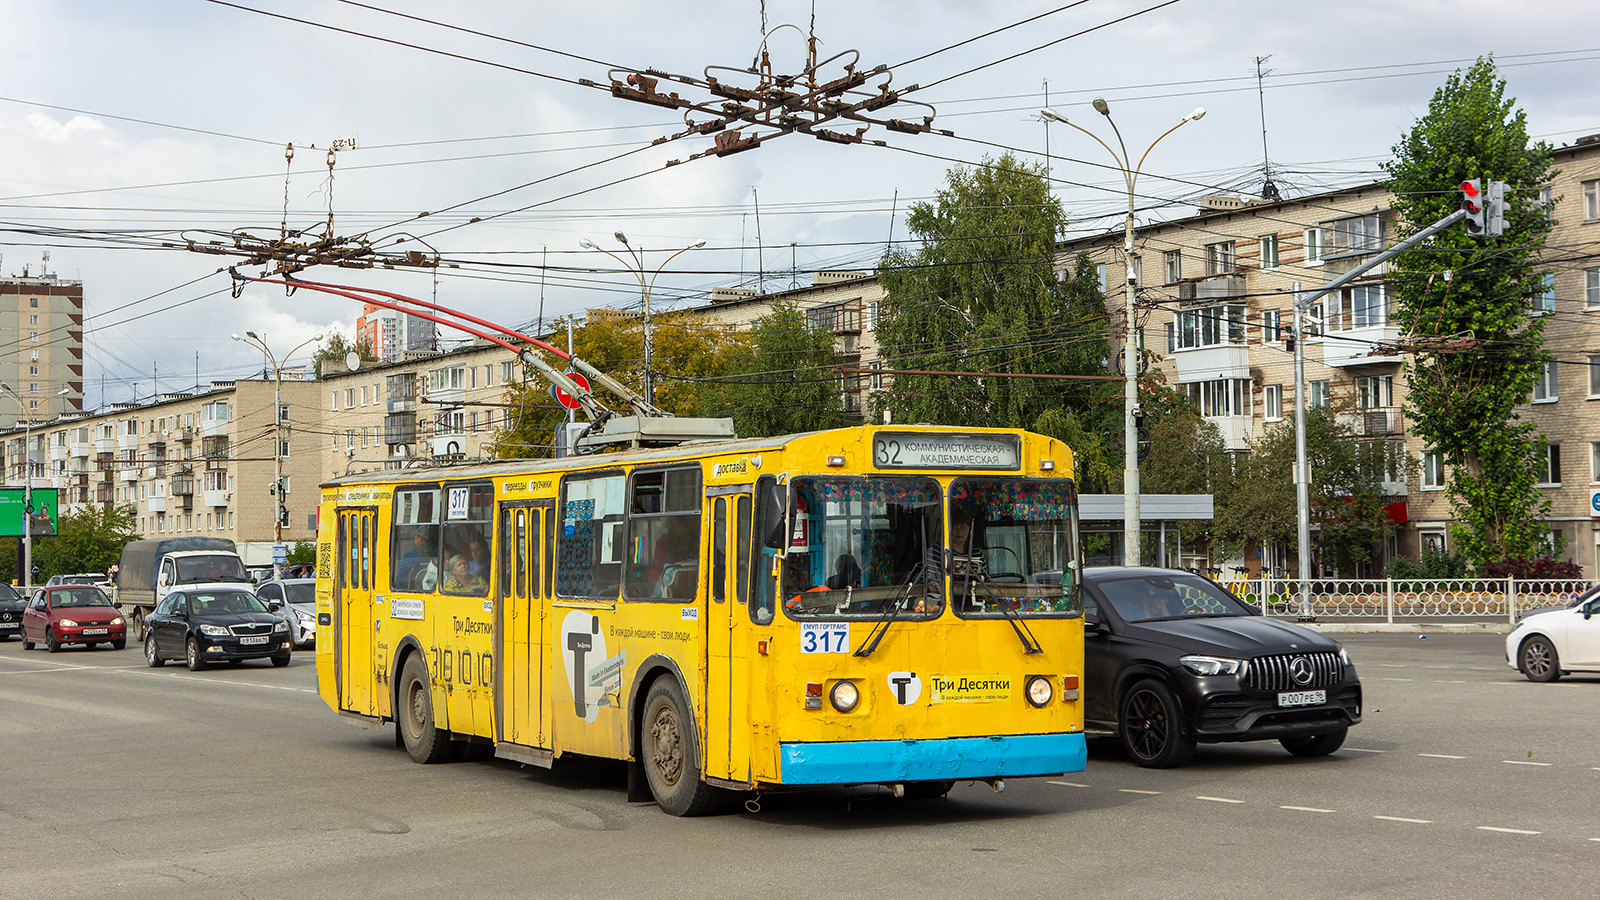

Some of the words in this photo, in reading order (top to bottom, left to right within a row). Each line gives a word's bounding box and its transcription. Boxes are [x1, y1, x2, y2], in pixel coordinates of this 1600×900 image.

[333, 138, 356, 147] П-23
[877, 439, 903, 464] 32
[904, 442, 1005, 453] КОММУНИСТИЧЕСКАЯ
[920, 454, 999, 464] АКАДЕМИЧЕСКАЯ
[504, 482, 527, 492] переезды
[531, 480, 552, 491] грузчики
[452, 489, 467, 509] 317
[681, 608, 698, 618] ВЫХОД
[453, 616, 464, 634] Три
[464, 617, 493, 636] Десятки
[610, 625, 615, 636] В
[615, 627, 634, 639] каждой
[634, 629, 656, 640] машине
[661, 631, 673, 641] свои
[804, 631, 847, 652] 317
[932, 678, 955, 692] Три
[957, 678, 1010, 692] Десятки
